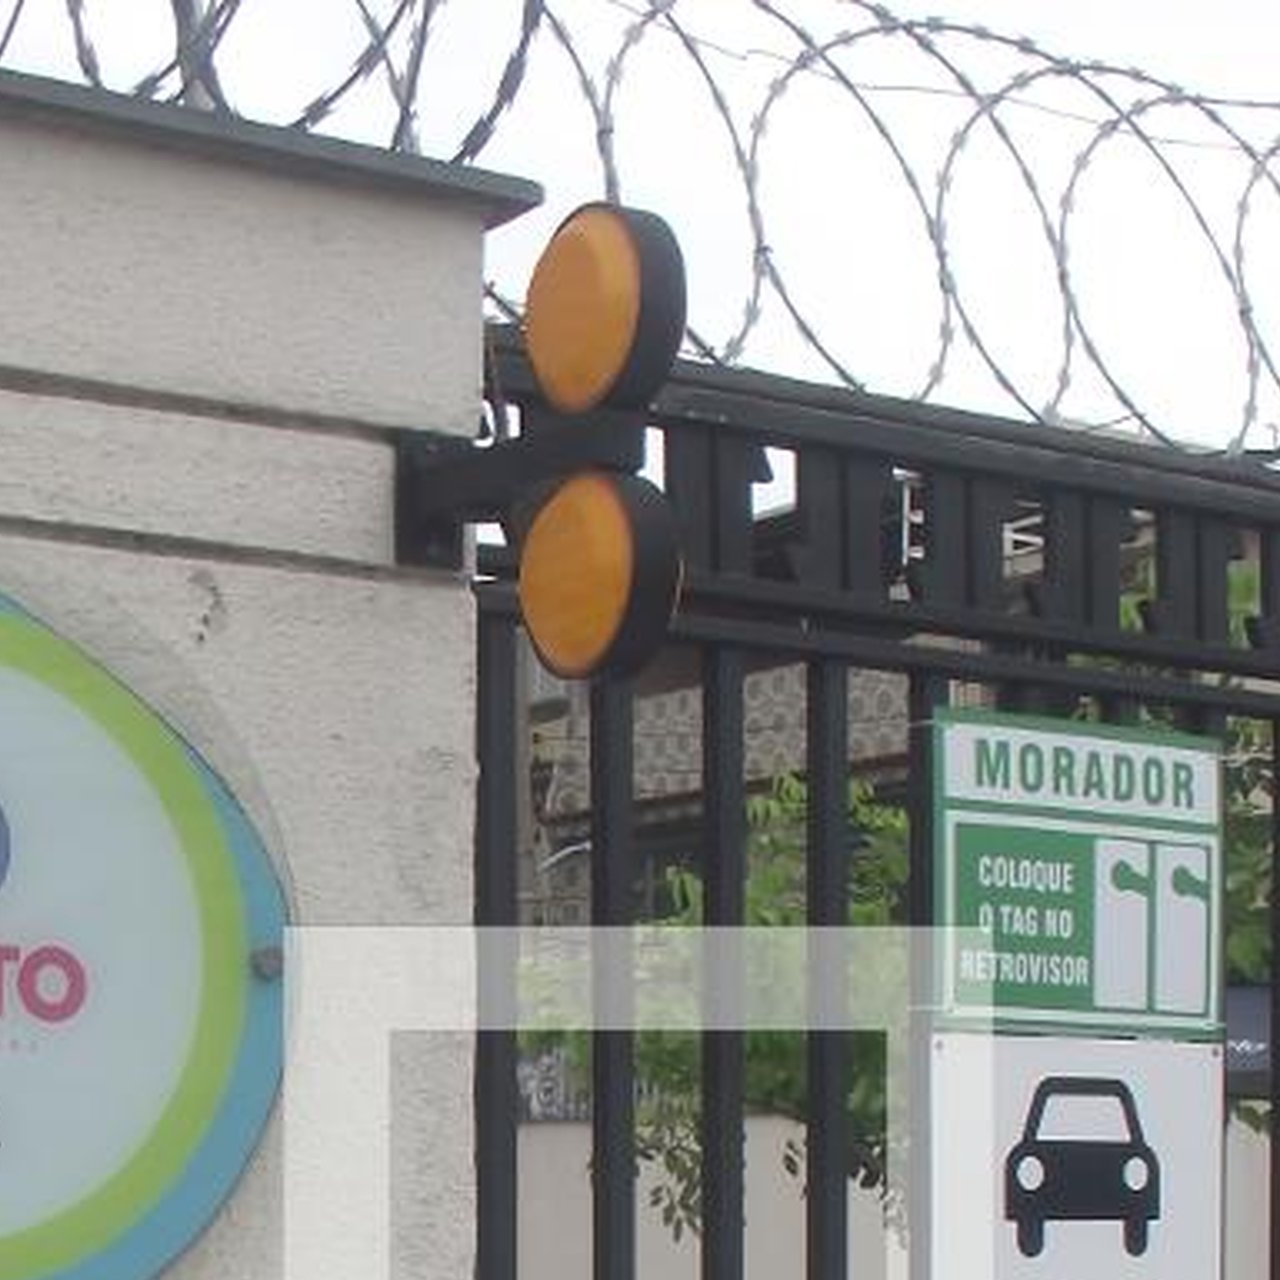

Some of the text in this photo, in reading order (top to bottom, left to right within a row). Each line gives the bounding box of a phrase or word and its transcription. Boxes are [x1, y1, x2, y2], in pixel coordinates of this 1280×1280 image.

[974, 738, 1195, 810] MORADOR
[978, 855, 1075, 893] COLOQUE
[978, 905, 1073, 938] O TAG NO
[960, 948, 1089, 986] RETROVISOR
